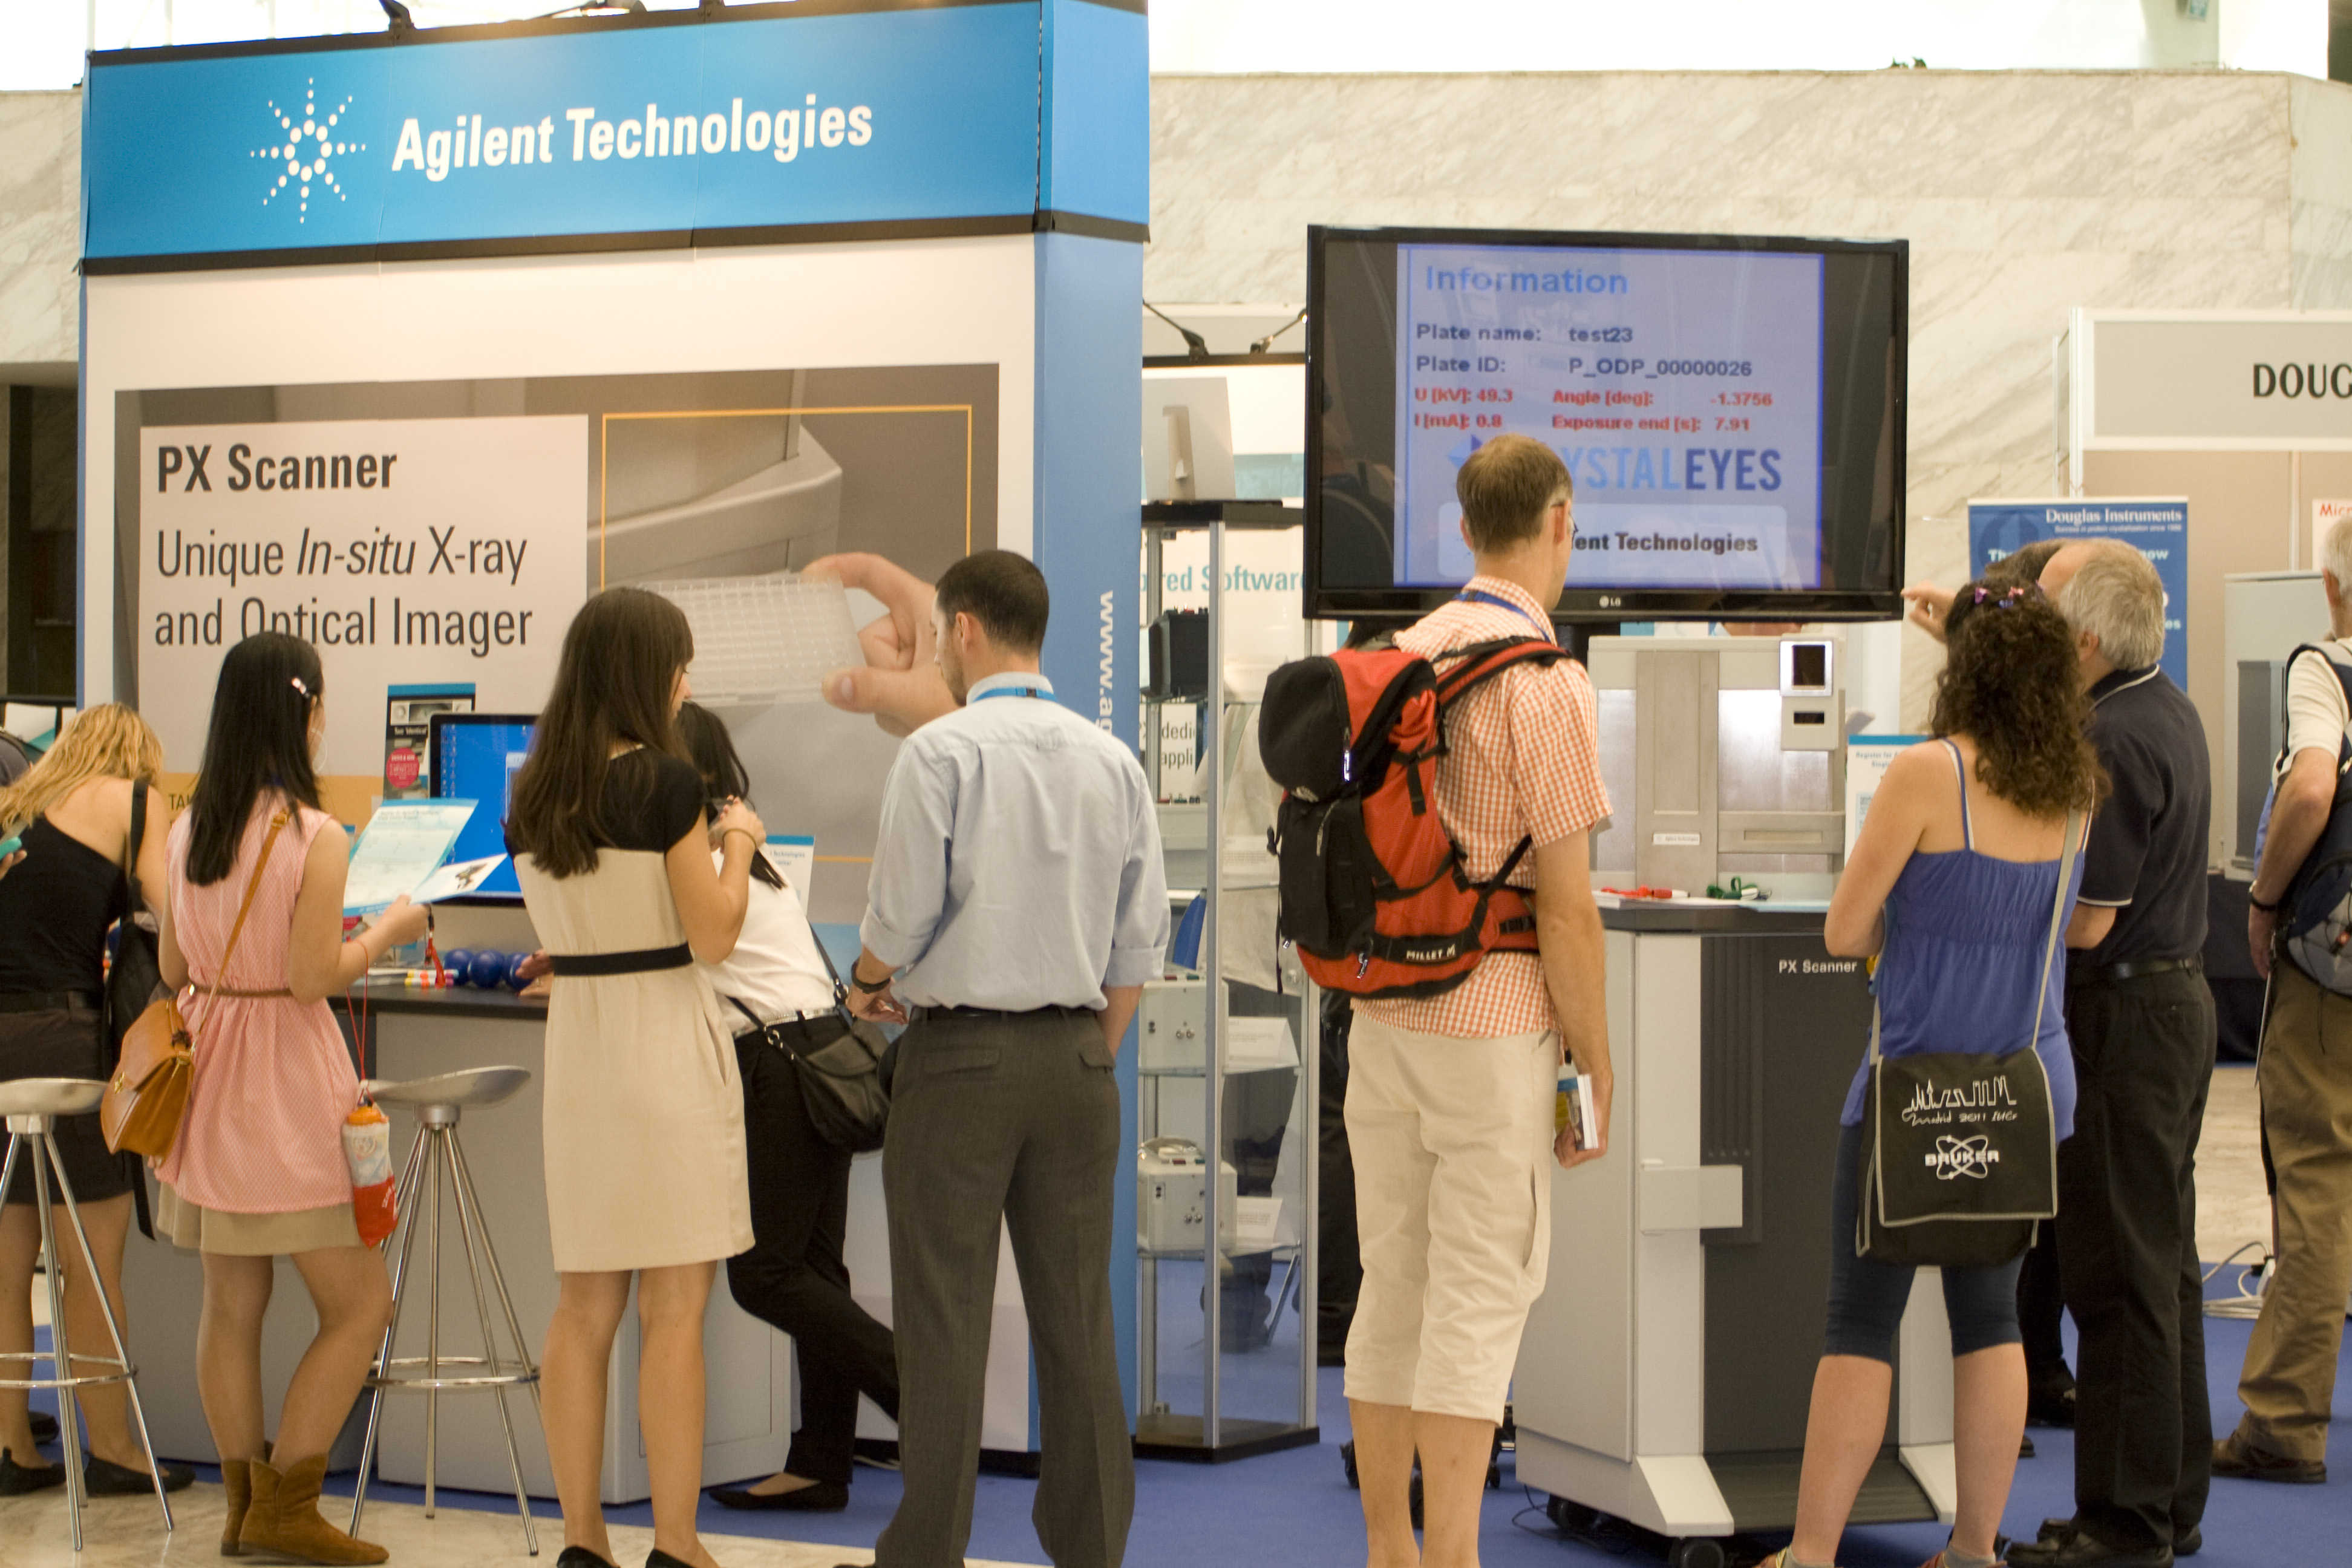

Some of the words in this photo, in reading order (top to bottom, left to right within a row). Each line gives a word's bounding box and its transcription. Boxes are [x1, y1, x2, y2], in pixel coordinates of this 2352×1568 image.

[391, 114, 555, 181] Agilent
[566, 93, 872, 162] Technologies
[1426, 266, 1629, 294] Information
[1416, 323, 1471, 340] Plate
[1478, 327, 1541, 341] name:
[1569, 327, 1633, 343] test23
[1416, 355, 1470, 372] Plate
[1478, 356, 1505, 373] ID:
[2253, 363, 2352, 399] DOUG
[1415, 388, 1427, 402] U
[1477, 388, 1513, 403] 49.3
[1553, 389, 1600, 406] Angle
[1711, 391, 1773, 407] -1.3756
[1476, 413, 1502, 428] 0.8
[1552, 414, 1633, 431] Exposure
[1638, 416, 1670, 430] end
[1714, 416, 1749, 431] 7.91
[157, 444, 212, 493] PX
[227, 443, 397, 491] Scanner
[1560, 446, 1782, 491] YSTALEYES
[2046, 508, 2101, 526] Douglas
[2105, 508, 2182, 523] Instruments
[1572, 534, 1609, 550] ent
[1615, 532, 1758, 555] Technologies
[157, 529, 284, 587] Unique
[296, 525, 417, 575] In-situ
[427, 524, 528, 586] X-ray
[155, 598, 223, 646] and
[394, 596, 533, 658] Imager
[1779, 959, 1797, 973] PX
[1803, 959, 1857, 973] Scanner
[1925, 1150, 1999, 1166] BRUKER
